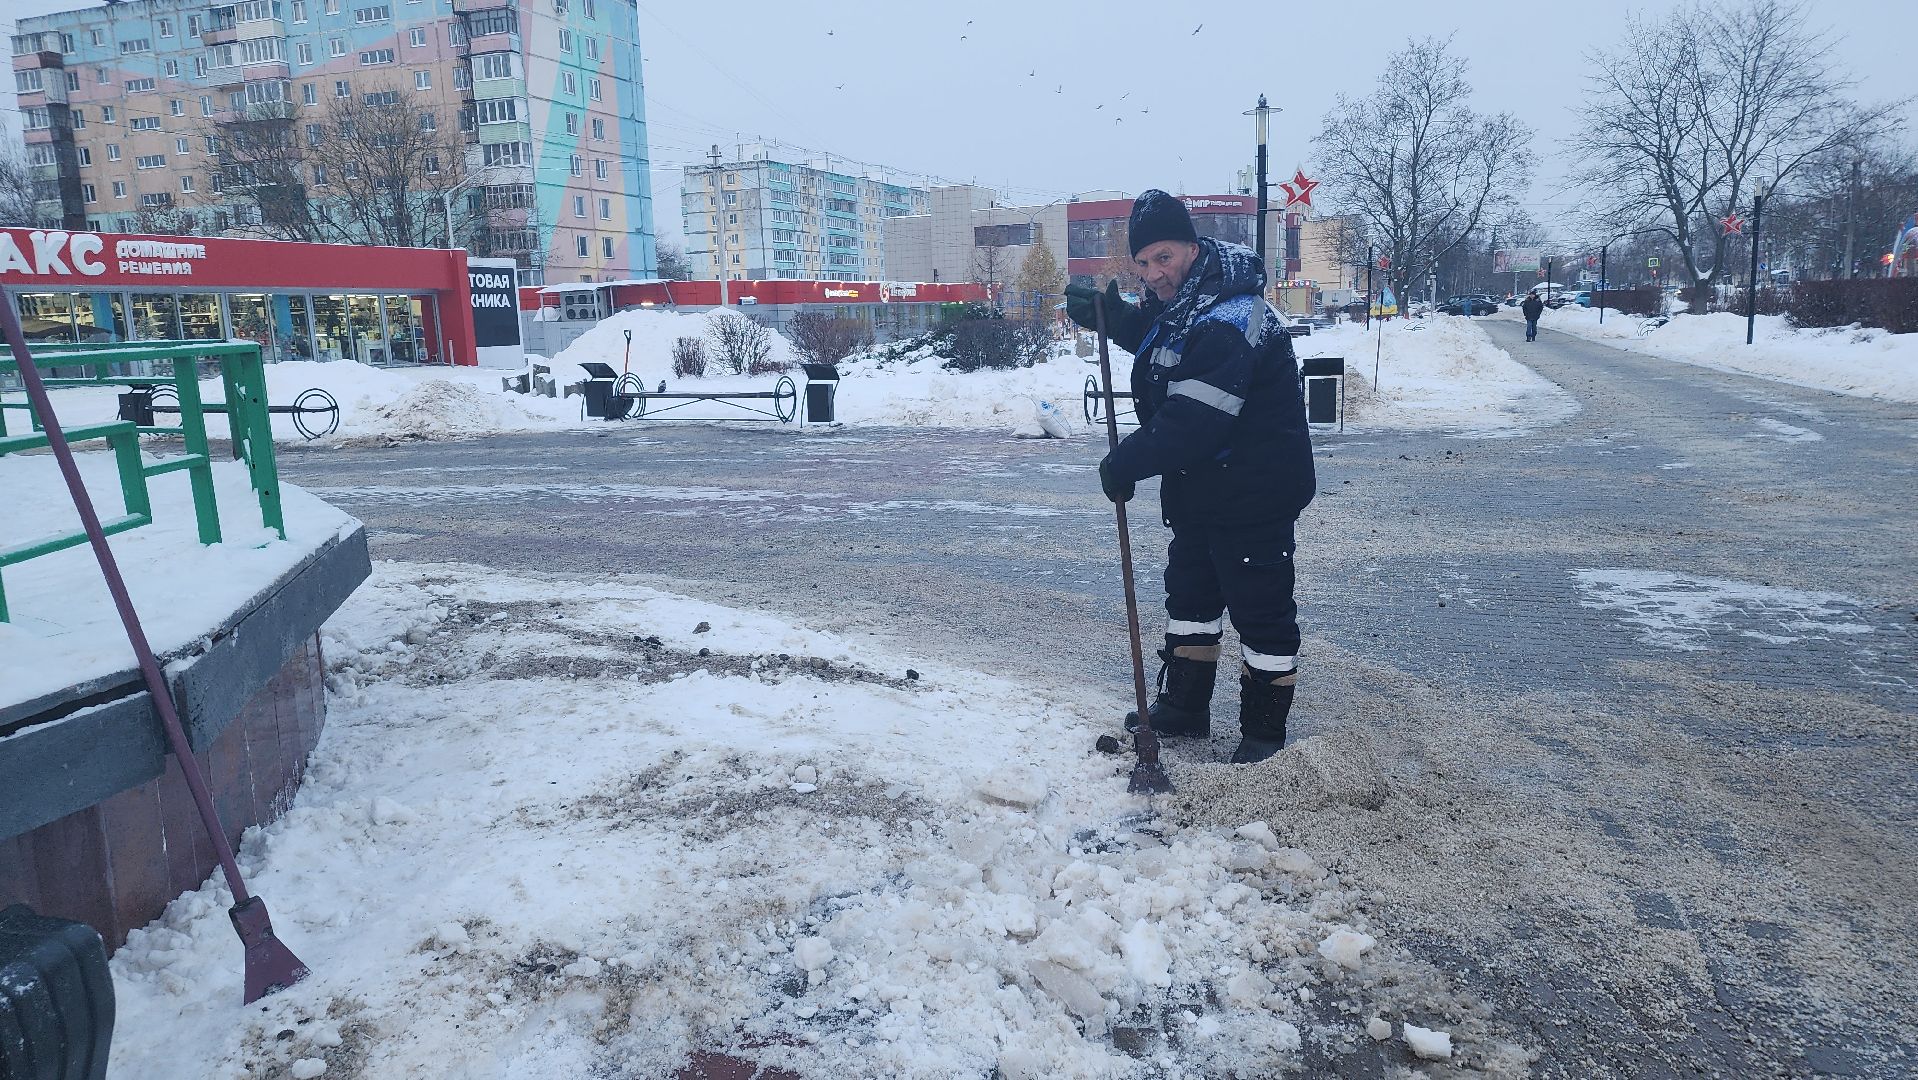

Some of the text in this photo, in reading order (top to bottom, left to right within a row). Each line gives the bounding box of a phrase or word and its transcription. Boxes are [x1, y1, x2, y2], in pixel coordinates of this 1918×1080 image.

[116, 240, 206, 259] ДОМАШНИЕ
[119, 260, 193, 275] РЕШЕНИЯ
[468, 273, 510, 289] ТОВАЯ
